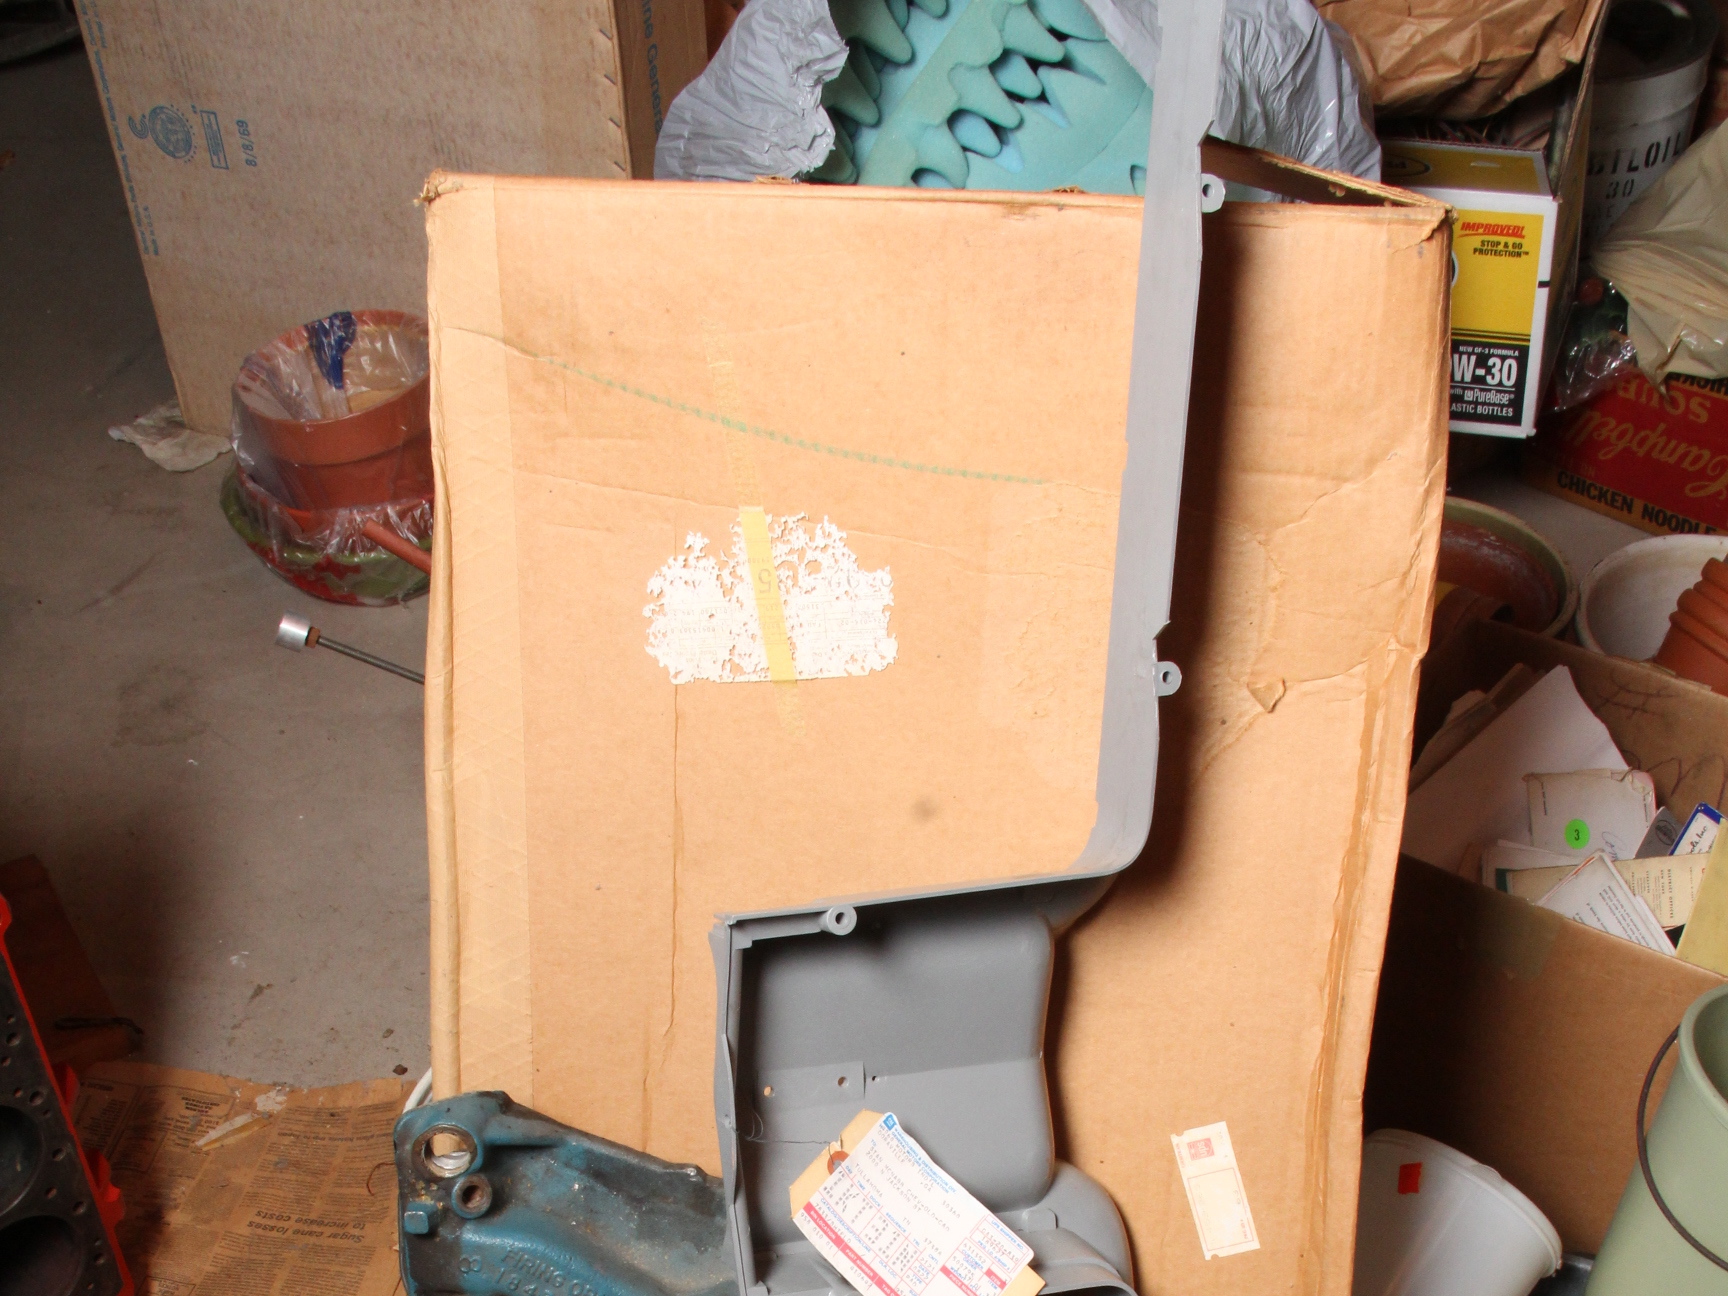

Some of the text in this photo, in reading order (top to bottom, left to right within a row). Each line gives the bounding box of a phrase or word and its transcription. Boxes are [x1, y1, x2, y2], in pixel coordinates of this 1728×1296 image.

[235, 119, 257, 167] 8/8/69
[1460, 221, 1525, 235] IMPROVED!
[1480, 239, 1500, 248] STOP
[1489, 348, 1518, 356] FORMULA
[1476, 405, 1512, 415] BOTTLES
[1555, 470, 1637, 514] CHICKEN
[1573, 829, 1581, 841] 3
[876, 1129, 906, 1164] DORAVILLE
[890, 1131, 949, 1194] GENERAL MOTORS CORPORATION
[920, 1159, 949, 1187] DISTRIBUTION
[853, 1162, 884, 1198] TULLAHOMA
[885, 1175, 912, 1203] JACKSON
[246, 1219, 364, 1243] Sugar cane losses
[254, 1208, 365, 1231] to increase costs
[855, 1179, 867, 1191] TIME
[868, 1194, 881, 1208] DOCK
[884, 1211, 907, 1233] SEQUENCE
[927, 1252, 940, 1265] CNTL
[990, 1219, 1025, 1251] UPS SHIPPER NO.
[808, 1209, 819, 1219] BIN
[815, 1217, 837, 1240] LOCATION
[844, 1248, 857, 1261] PART
[855, 1258, 874, 1277] NUMBER
[880, 1283, 891, 1294] TAG
[501, 1247, 566, 1288] FIRING
[911, 1273, 923, 1285] TYPE
[917, 1264, 930, 1276] DATE
[948, 1273, 962, 1286] PIECE
[961, 1248, 1001, 1286] CUSTOMER ITEM
[962, 1256, 998, 1290] ORDER ITEM
